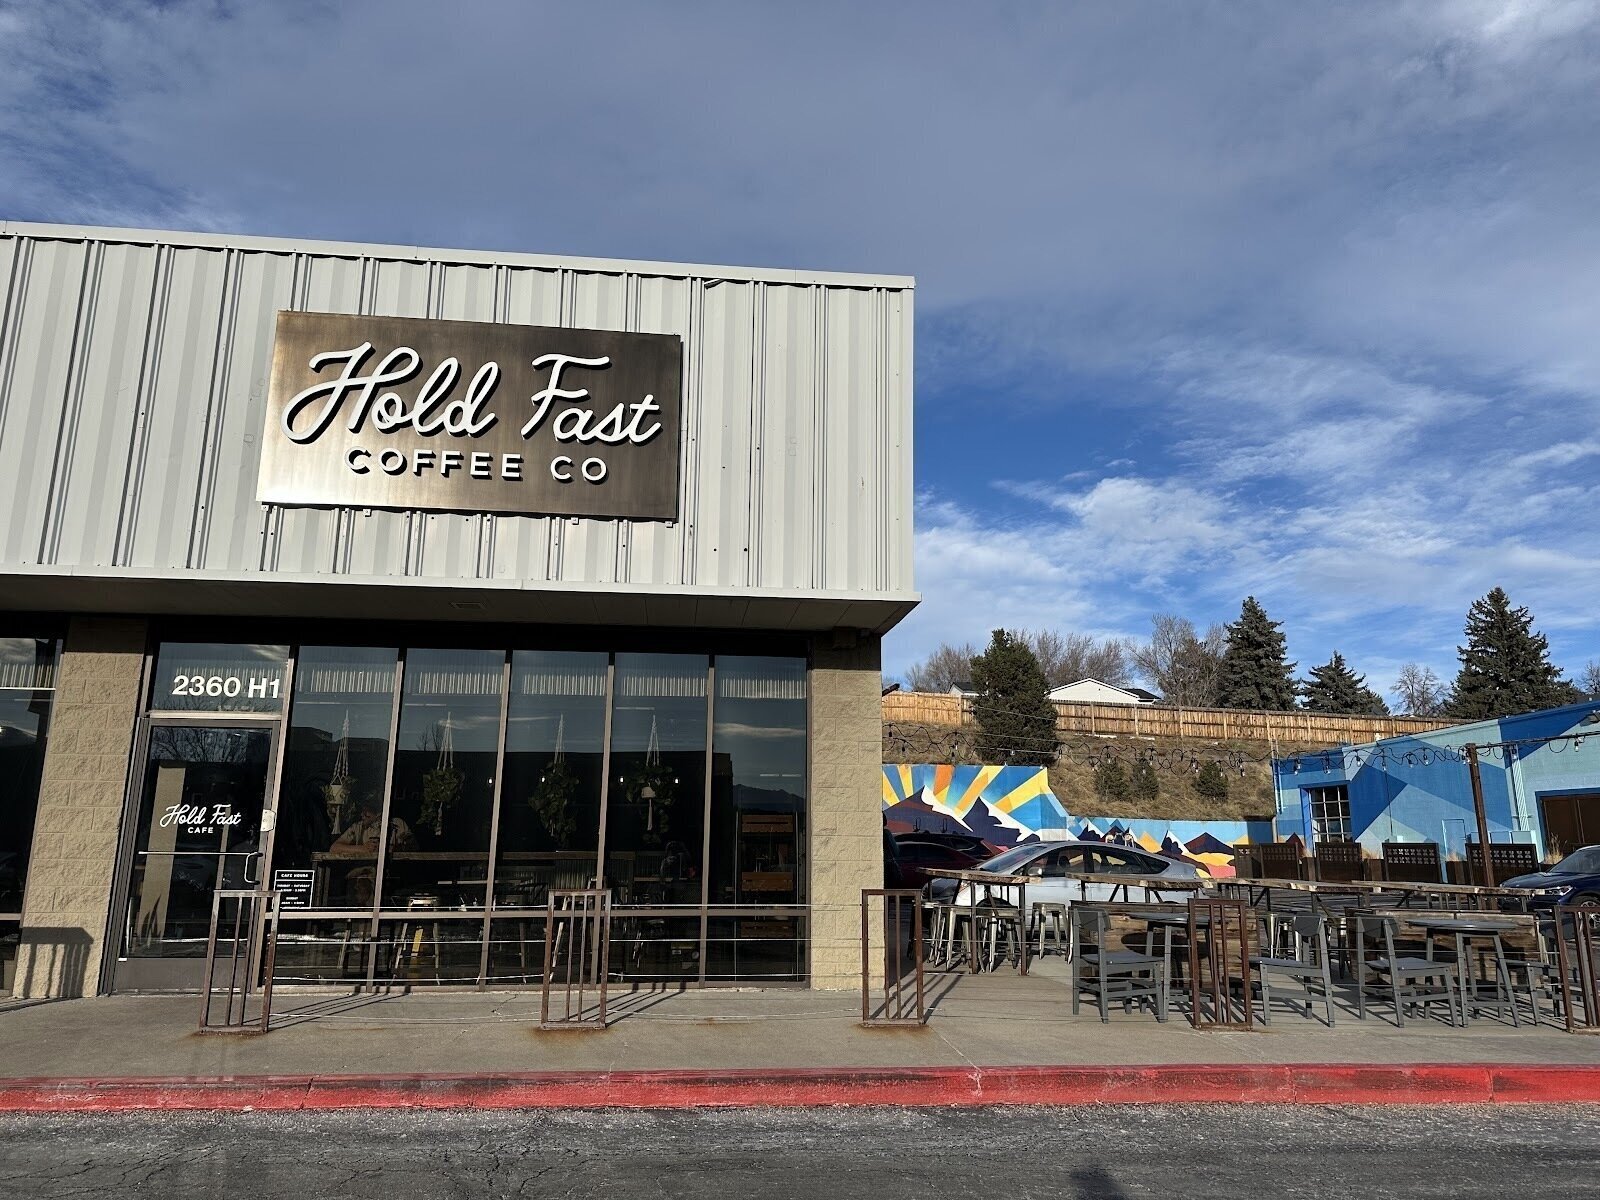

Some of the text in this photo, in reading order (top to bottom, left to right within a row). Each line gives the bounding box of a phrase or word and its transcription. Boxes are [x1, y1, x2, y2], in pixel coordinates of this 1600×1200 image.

[281, 342, 661, 443] Hold Fast
[345, 447, 607, 481] COFFEE CO
[172, 675, 279, 698] 2360 H1
[160, 804, 241, 827] Hold Fast
